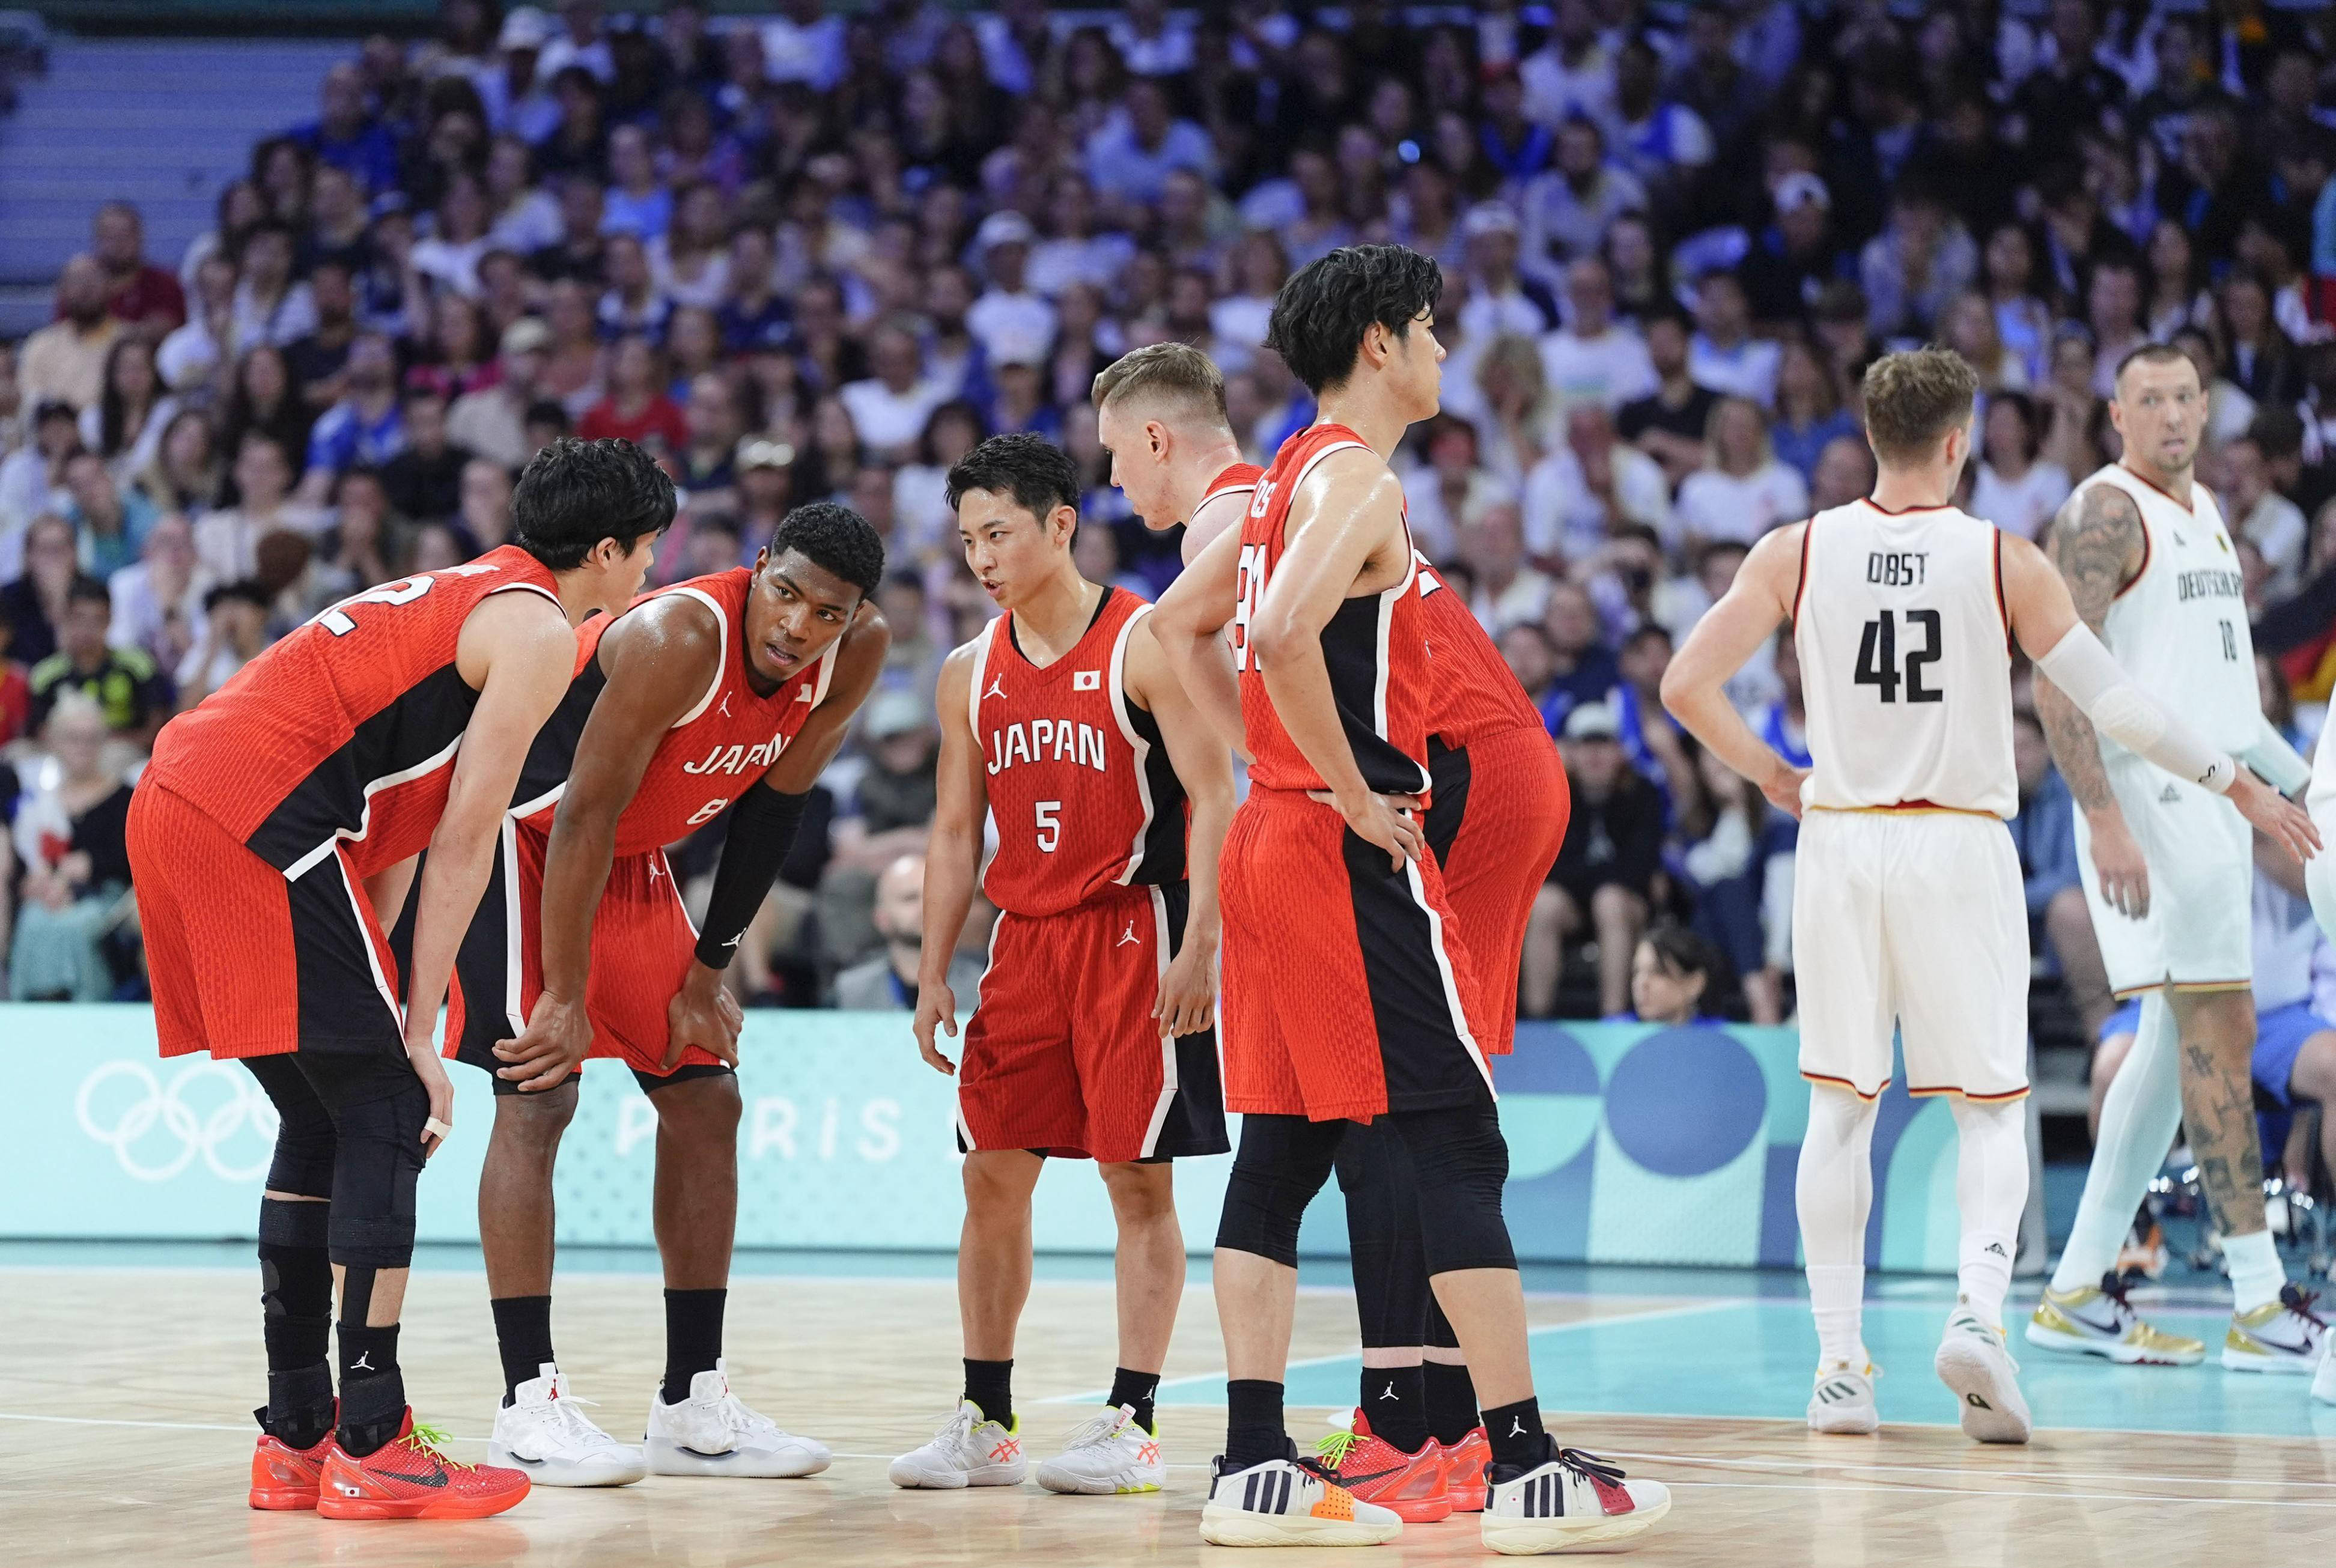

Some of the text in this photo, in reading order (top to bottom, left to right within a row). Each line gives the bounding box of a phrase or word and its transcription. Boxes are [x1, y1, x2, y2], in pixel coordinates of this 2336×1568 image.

[1867, 552, 1929, 586] OBST
[1854, 609, 1943, 703] 42
[987, 719, 1106, 776] JAPAN
[686, 798, 729, 825] 8
[1035, 800, 1062, 853] 5
[613, 1095, 902, 1162] PRIS
